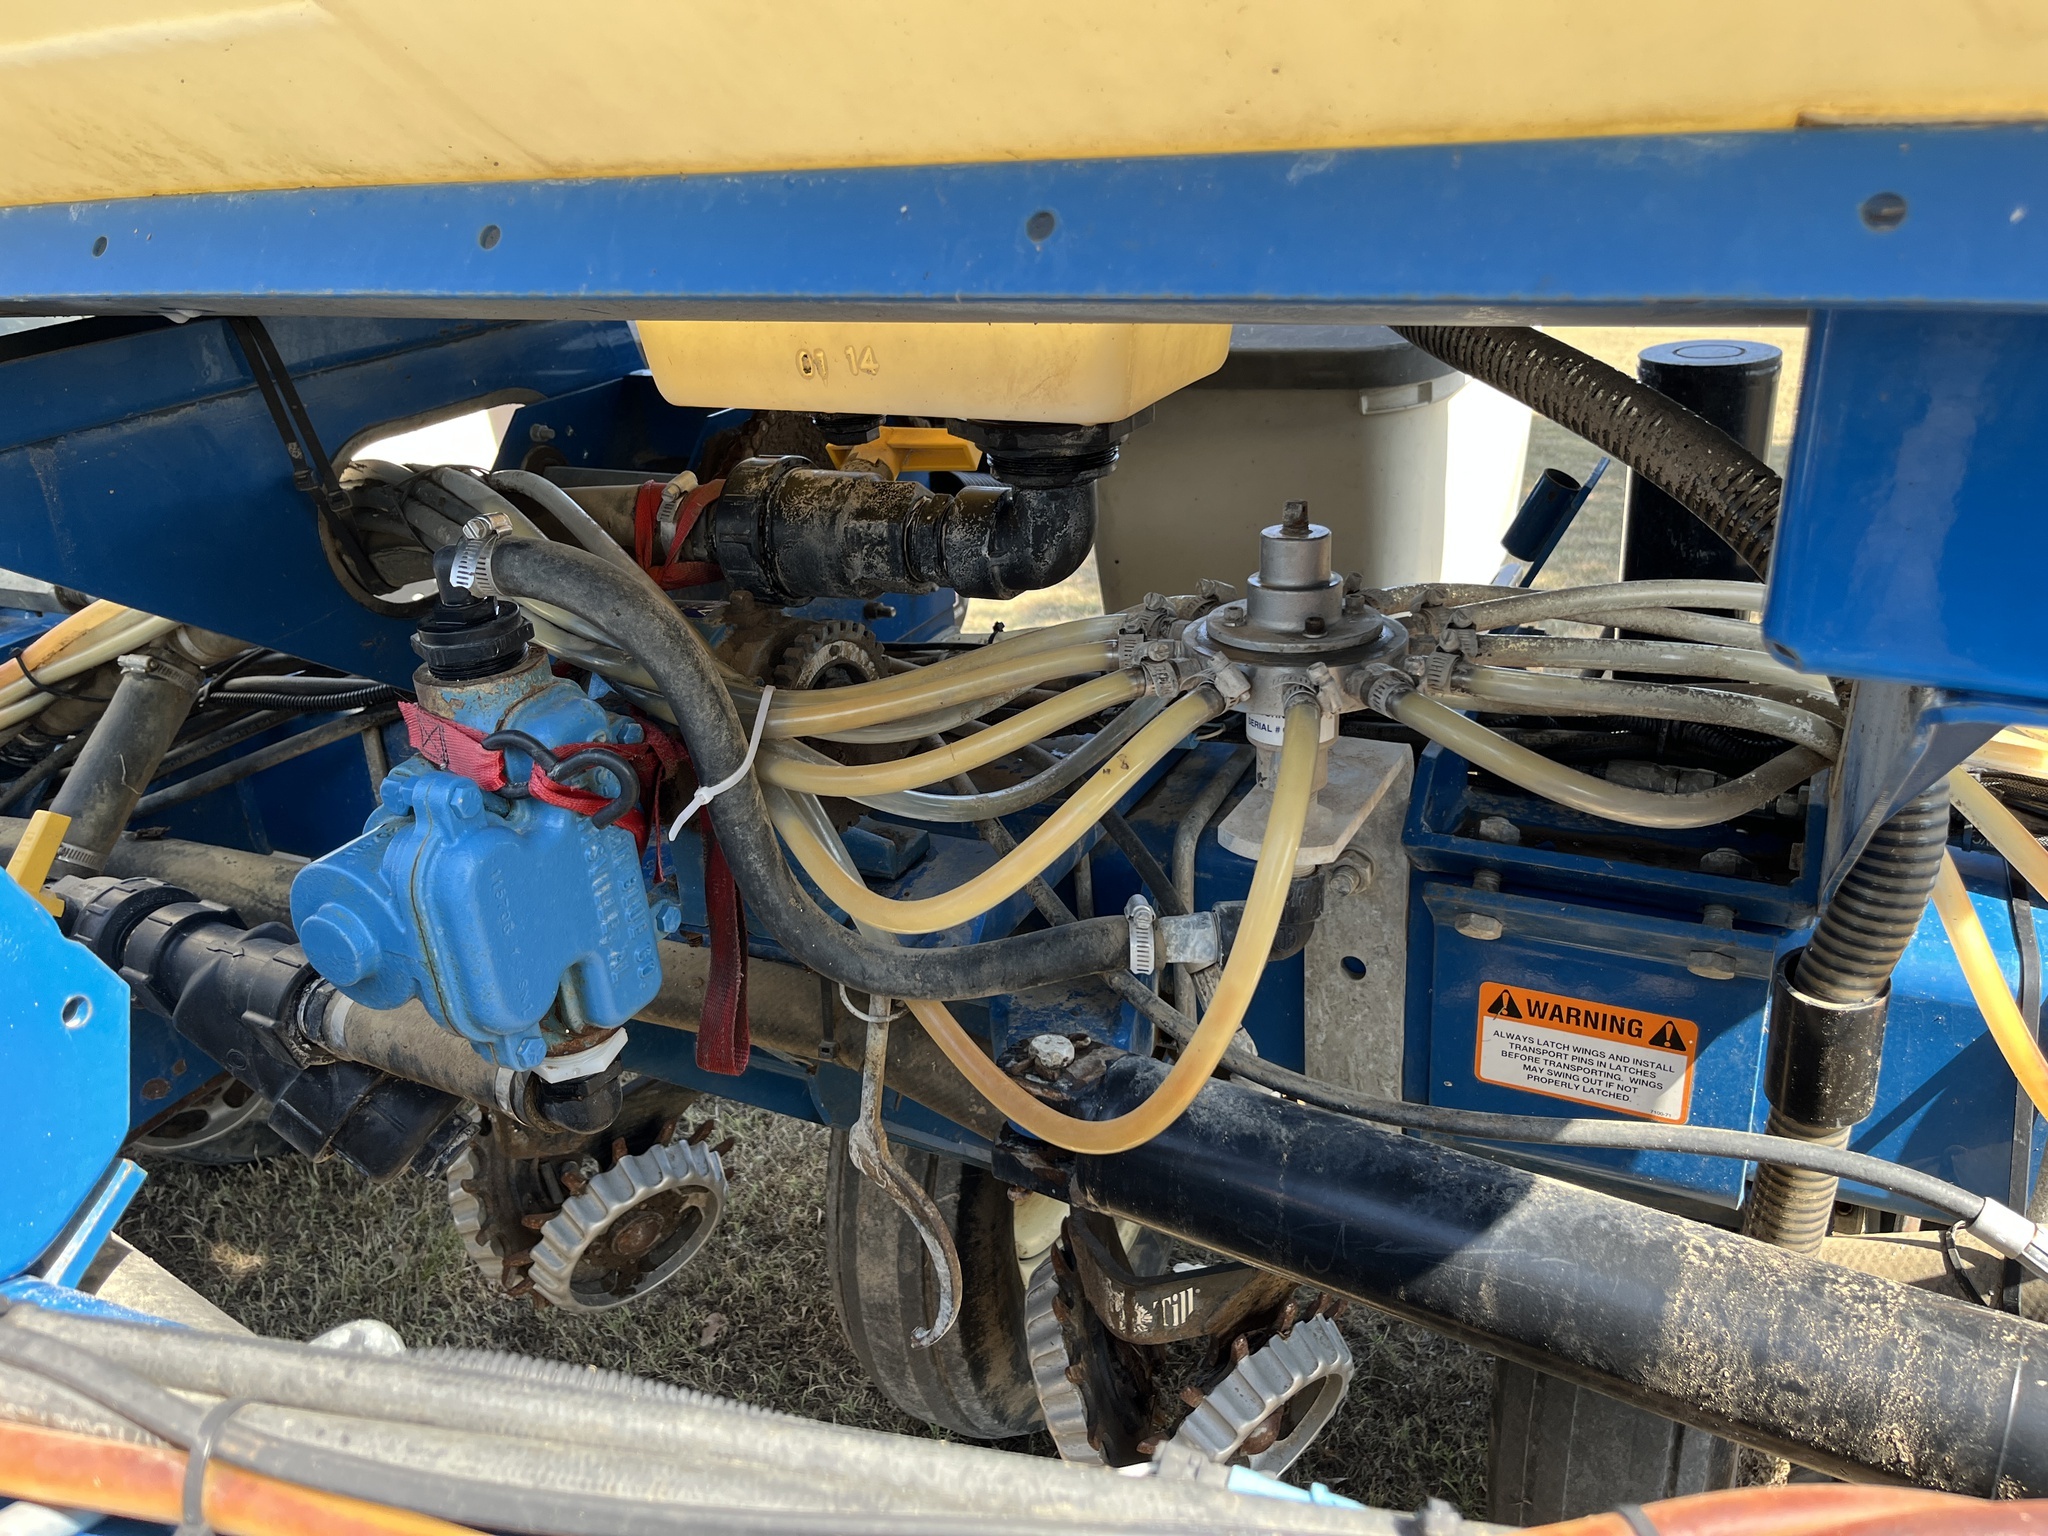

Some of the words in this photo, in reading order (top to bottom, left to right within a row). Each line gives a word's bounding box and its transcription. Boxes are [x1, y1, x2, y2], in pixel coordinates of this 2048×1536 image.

[845, 345, 880, 376] 14
[1248, 717, 1272, 732] SERIAL
[1526, 998, 1643, 1038] WARNING
[1493, 1030, 1534, 1044] ALWAYS
[1537, 1038, 1569, 1051] LATCH
[1572, 1045, 1606, 1058] WINGS
[1608, 1053, 1630, 1063] AND
[1632, 1058, 1675, 1073] INSTALL
[1501, 1050, 1541, 1064] BEFORE
[1543, 1058, 1623, 1081] TRANSPORTING.
[1629, 1077, 1663, 1090] WINGS
[1509, 1042, 1569, 1060] TRANSPORT
[1571, 1055, 1594, 1066] PINS
[1596, 1060, 1607, 1068] IN
[1609, 1061, 1657, 1079] LATCHES
[1522, 1064, 1544, 1074] MAY
[1546, 1068, 1580, 1081] SWING
[1582, 1076, 1603, 1086] OUT
[1617, 1084, 1638, 1094] NOT
[1527, 1074, 1580, 1091] PROPERLY
[1582, 1085, 1632, 1102] LATCHED.
[1153, 1287, 1194, 1327] Till
